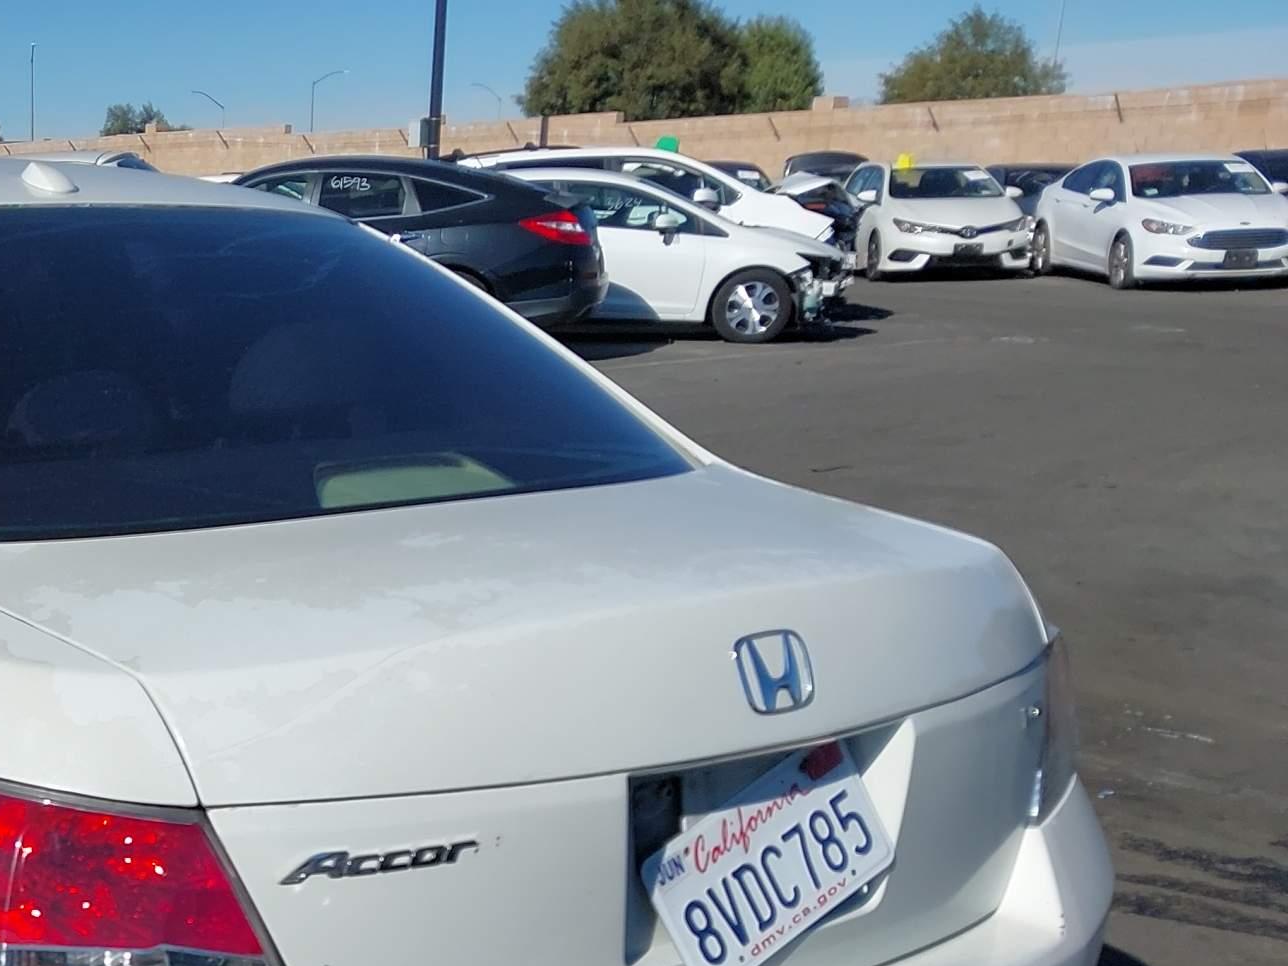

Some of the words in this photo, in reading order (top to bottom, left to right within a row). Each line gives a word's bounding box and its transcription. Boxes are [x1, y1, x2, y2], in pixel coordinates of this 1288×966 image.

[330, 175, 371, 191] 61593
[279, 840, 480, 885] Accor
[694, 781, 810, 874] California
[683, 789, 872, 965] 8VDC785
[751, 877, 848, 957] dmv.ca.gov
